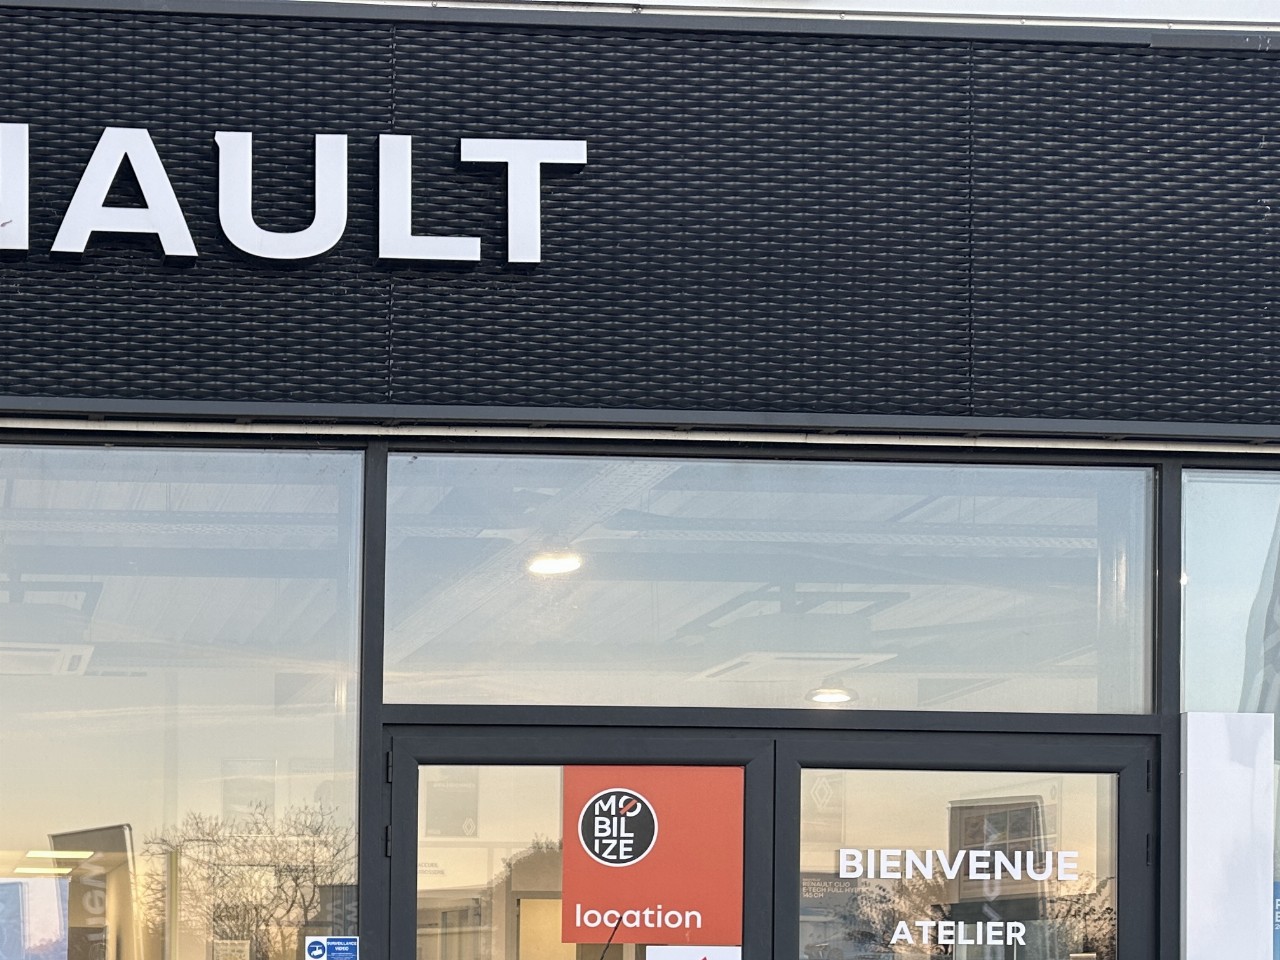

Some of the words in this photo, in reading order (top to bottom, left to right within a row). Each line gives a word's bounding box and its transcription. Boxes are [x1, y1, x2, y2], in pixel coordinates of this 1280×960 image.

[839, 848, 1079, 881] BIENVENUE
[575, 903, 702, 929] location
[890, 921, 1027, 946] ATELIER
